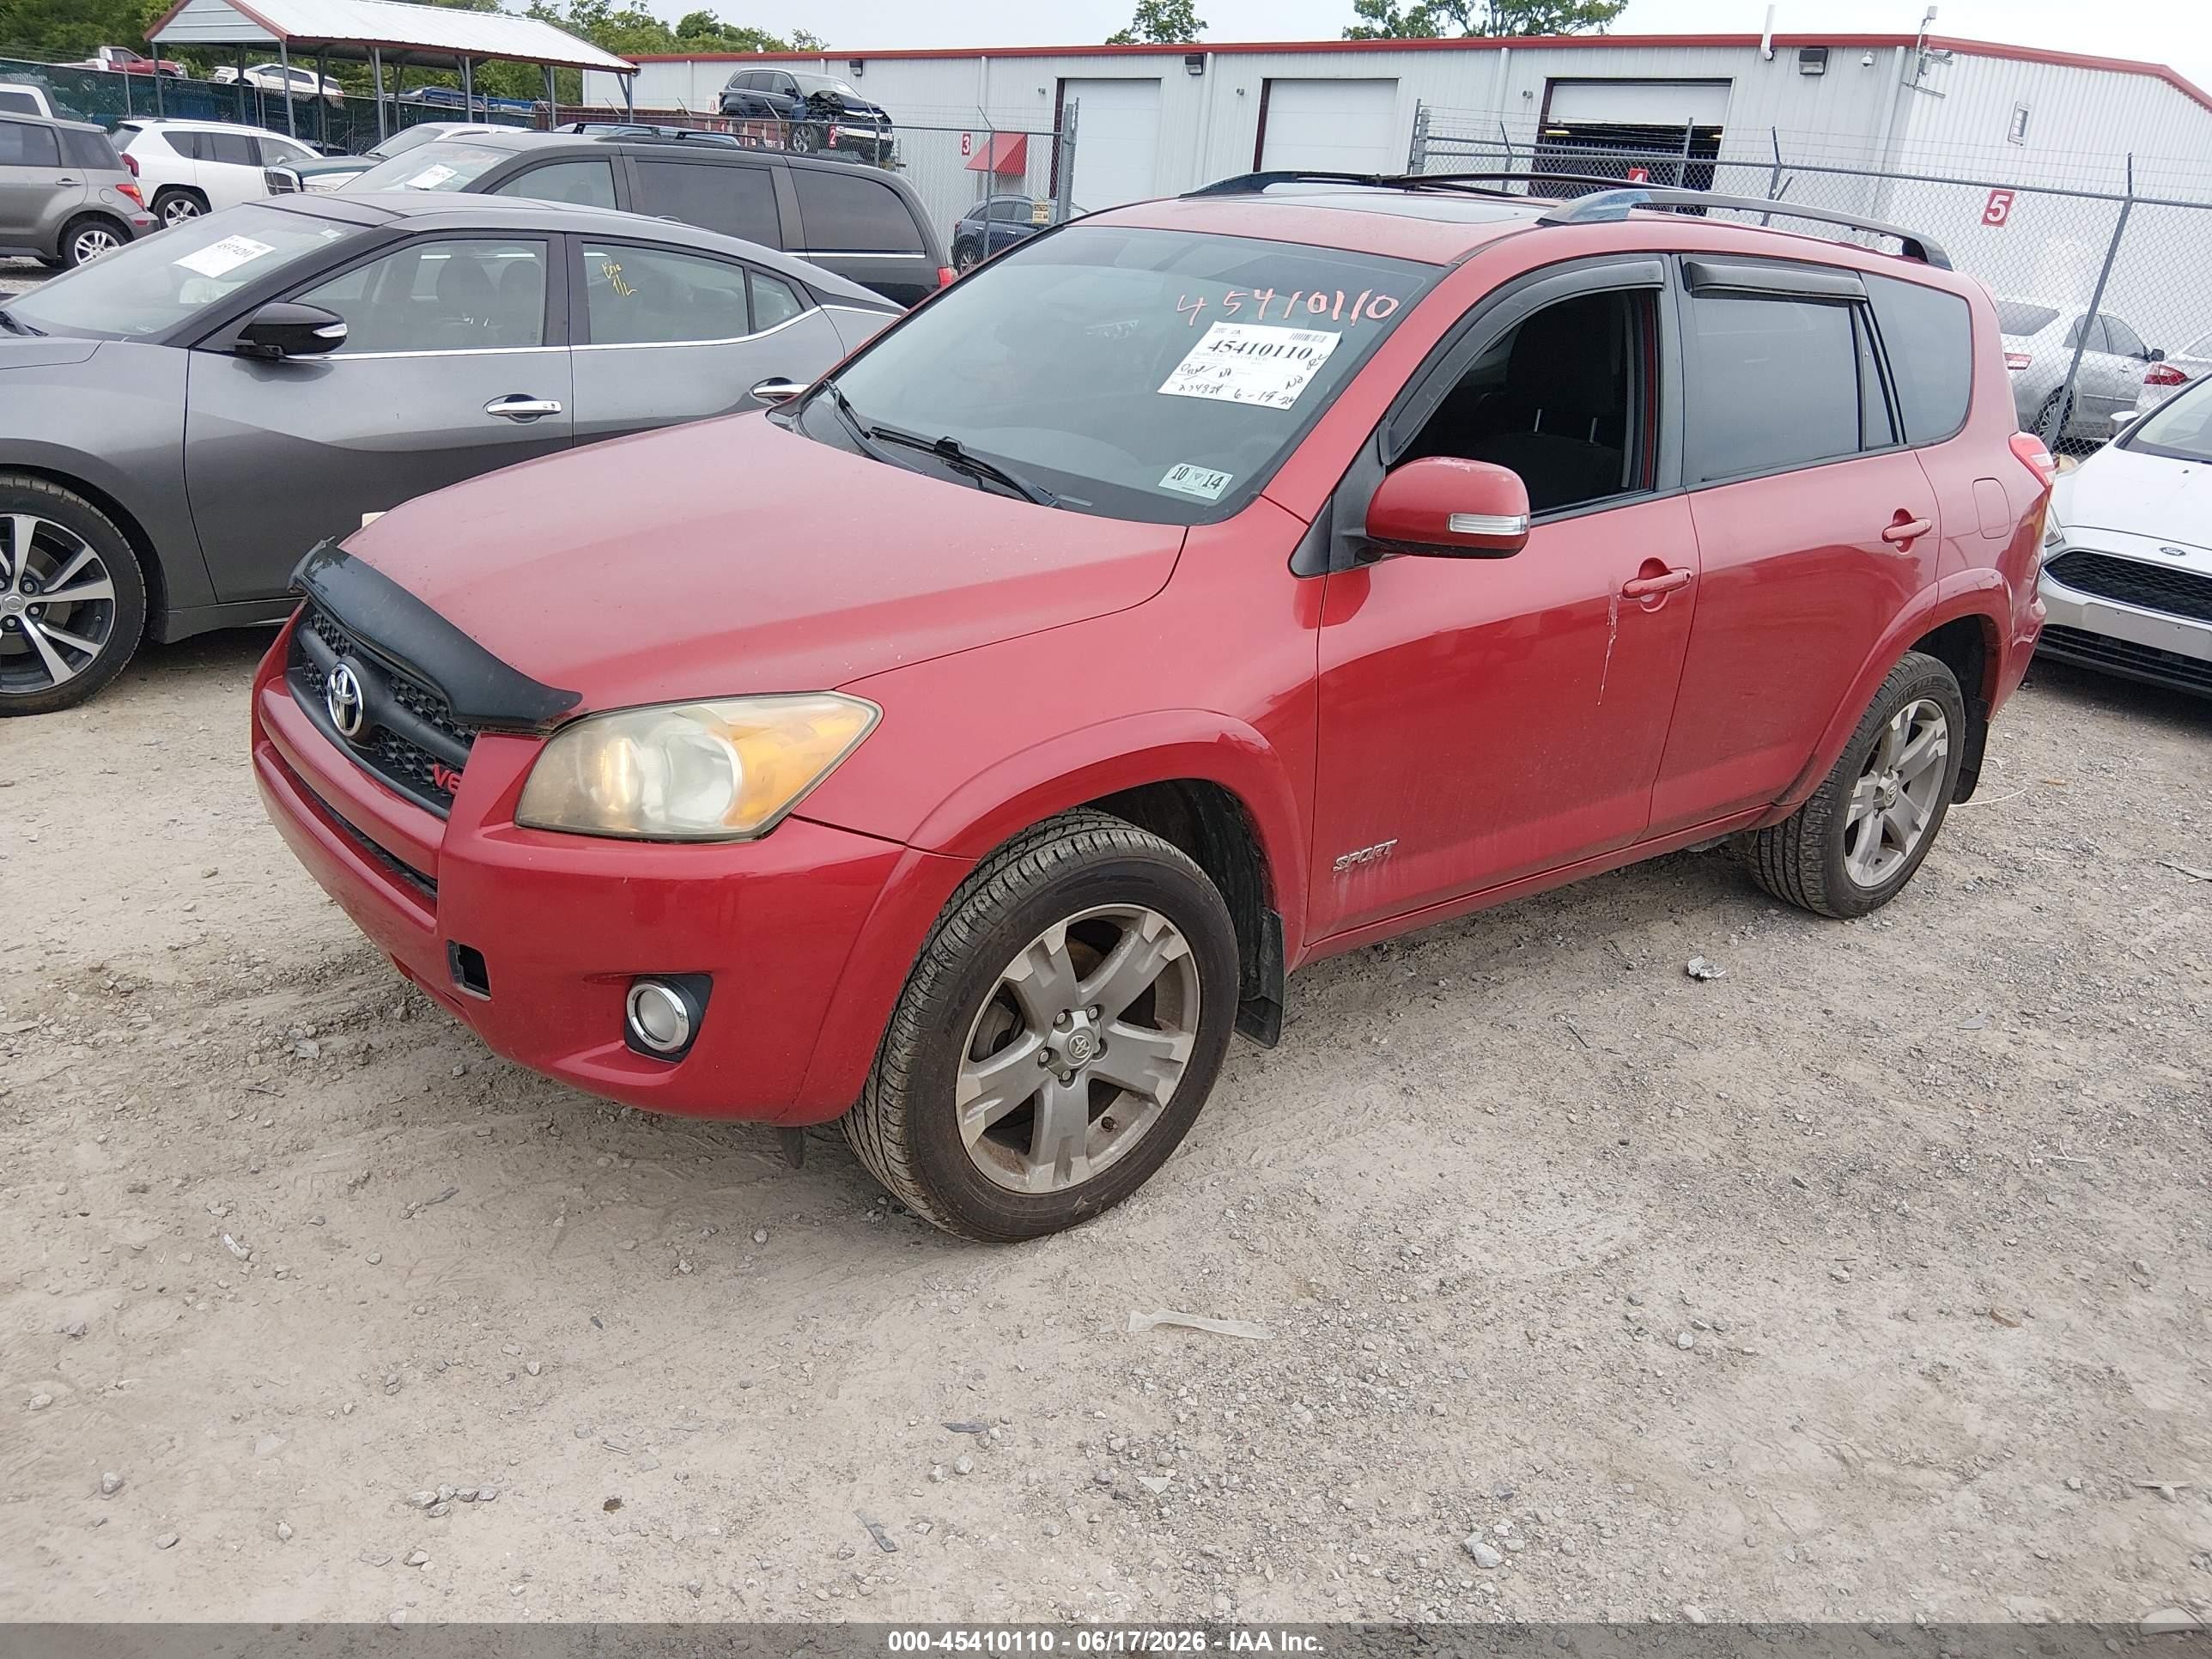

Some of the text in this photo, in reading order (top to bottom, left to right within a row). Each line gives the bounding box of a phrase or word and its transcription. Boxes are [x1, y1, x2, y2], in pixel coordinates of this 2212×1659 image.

[830, 128, 836, 145] 2
[962, 135, 970, 154] 3
[1986, 194, 2010, 222] 5
[1176, 288, 1400, 326] 45410110
[1207, 339, 1313, 361] 45410110
[1171, 466, 1224, 489] 10 14
[1332, 838, 1398, 872] SPORT
